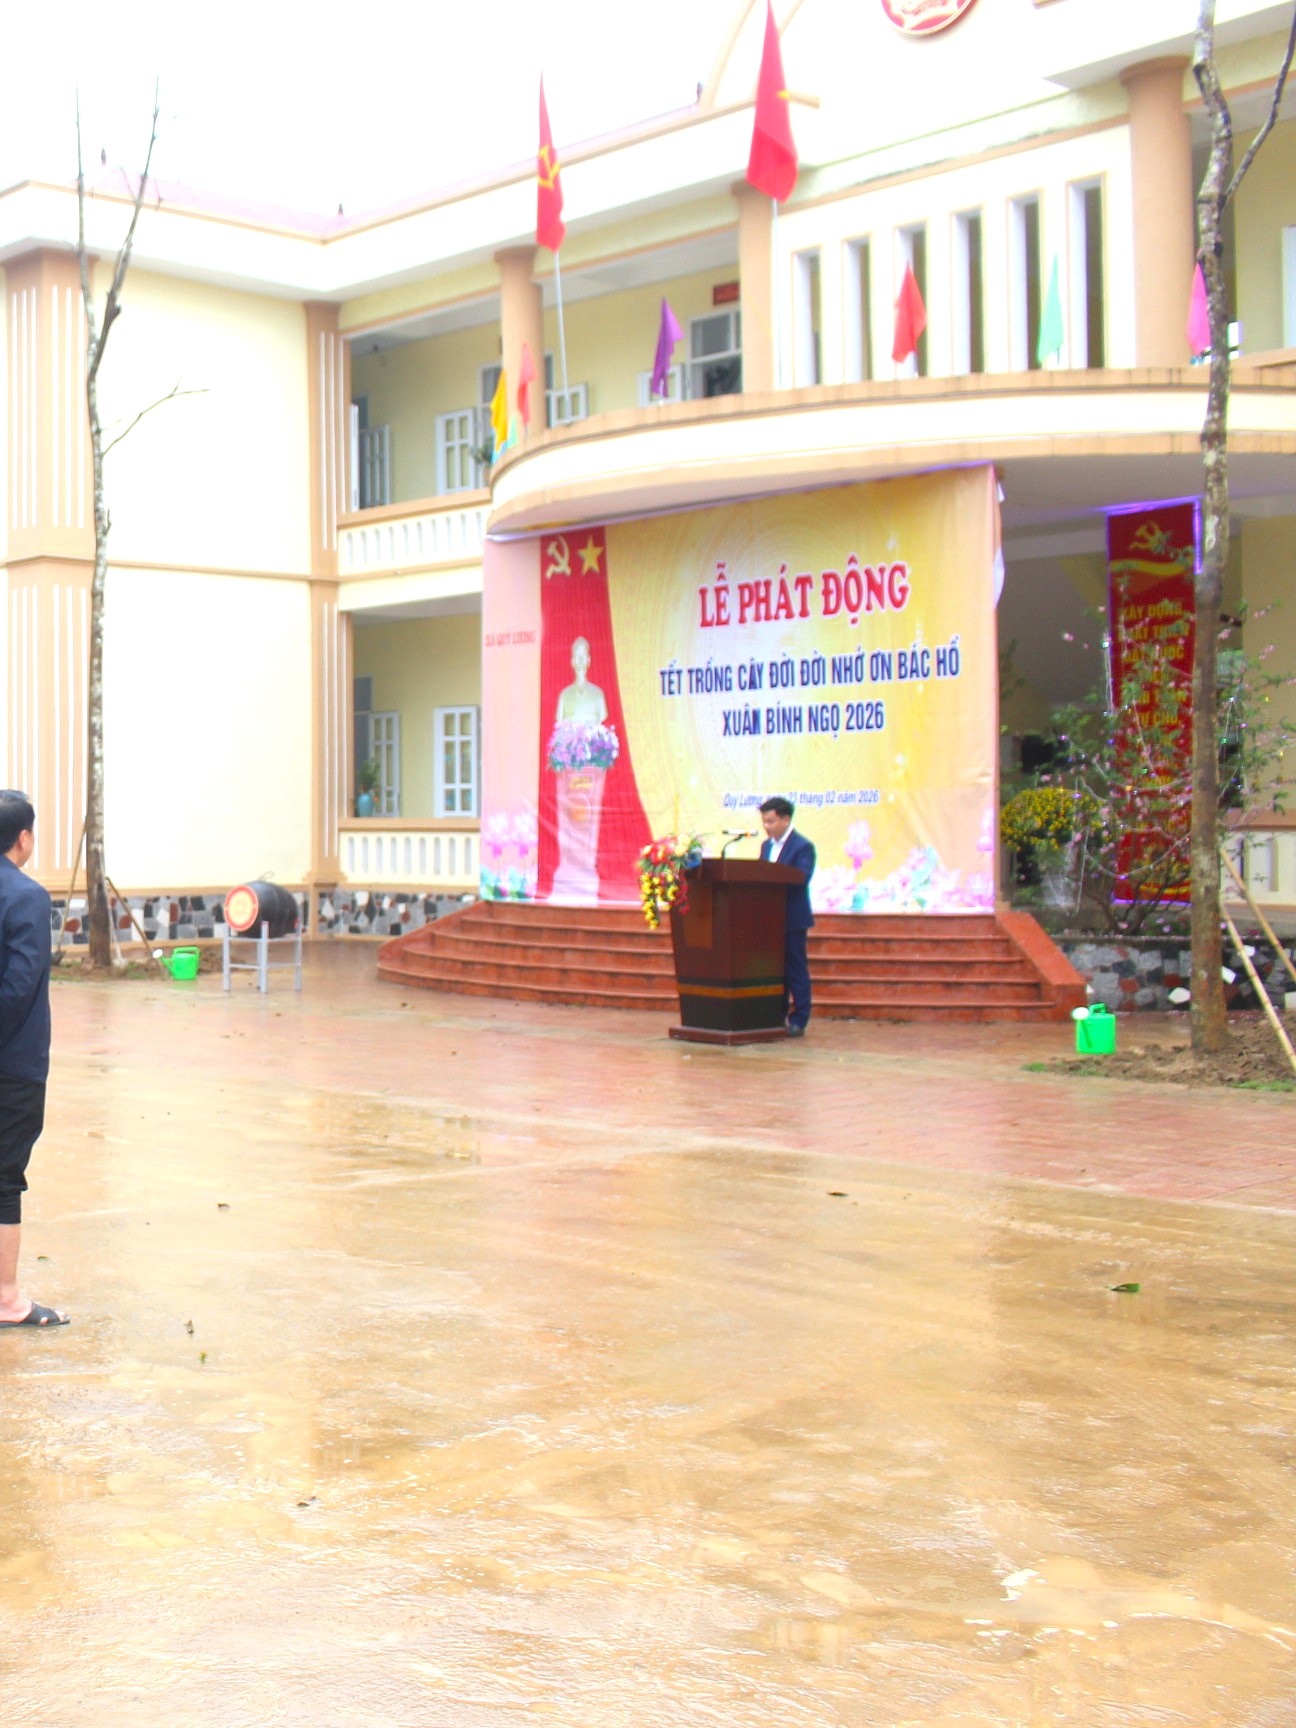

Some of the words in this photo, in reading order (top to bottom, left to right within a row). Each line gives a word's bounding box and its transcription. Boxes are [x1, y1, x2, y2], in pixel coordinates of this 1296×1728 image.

[698, 561, 731, 628] LỄ
[737, 563, 814, 625] PHÁT
[821, 554, 910, 625] ĐỘNG
[659, 659, 683, 696] TẾT
[687, 656, 733, 694] TRỒNG
[738, 656, 764, 691] CÂY
[769, 651, 795, 689] ĐỜI
[800, 649, 826, 687] ĐỜI
[831, 645, 865, 684] NHỚ
[869, 648, 892, 682] ƠN
[897, 642, 931, 680] BÁC
[935, 634, 960, 677] HỒ
[722, 702, 761, 737] XUÂN
[766, 700, 803, 734] BÍNH
[808, 703, 841, 739] NGỌ
[845, 700, 885, 731] 2026
[825, 791, 835, 803] 02
[837, 791, 856, 803] năm
[858, 789, 879, 803] 2026
